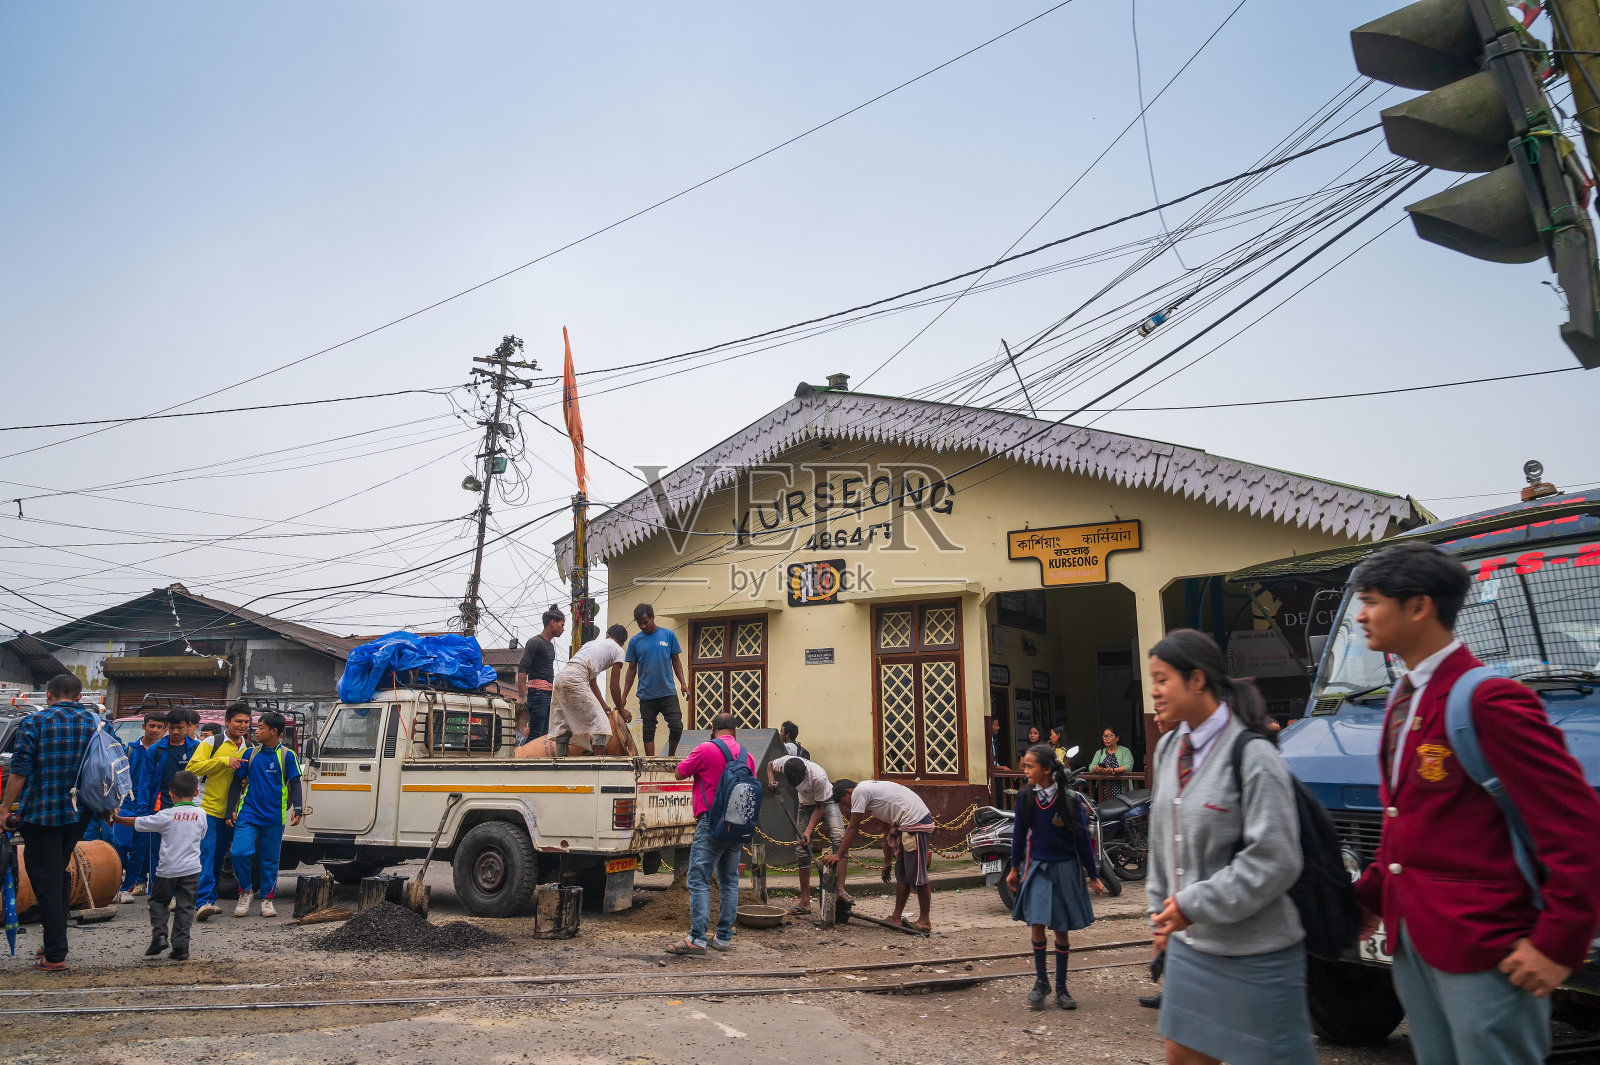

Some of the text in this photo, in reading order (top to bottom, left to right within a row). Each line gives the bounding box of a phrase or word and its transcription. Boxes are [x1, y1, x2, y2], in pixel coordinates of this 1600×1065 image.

[732, 476, 956, 545] KURSEONG
[1048, 555, 1099, 569] KURSEONG
[608, 858, 634, 871] STOP
